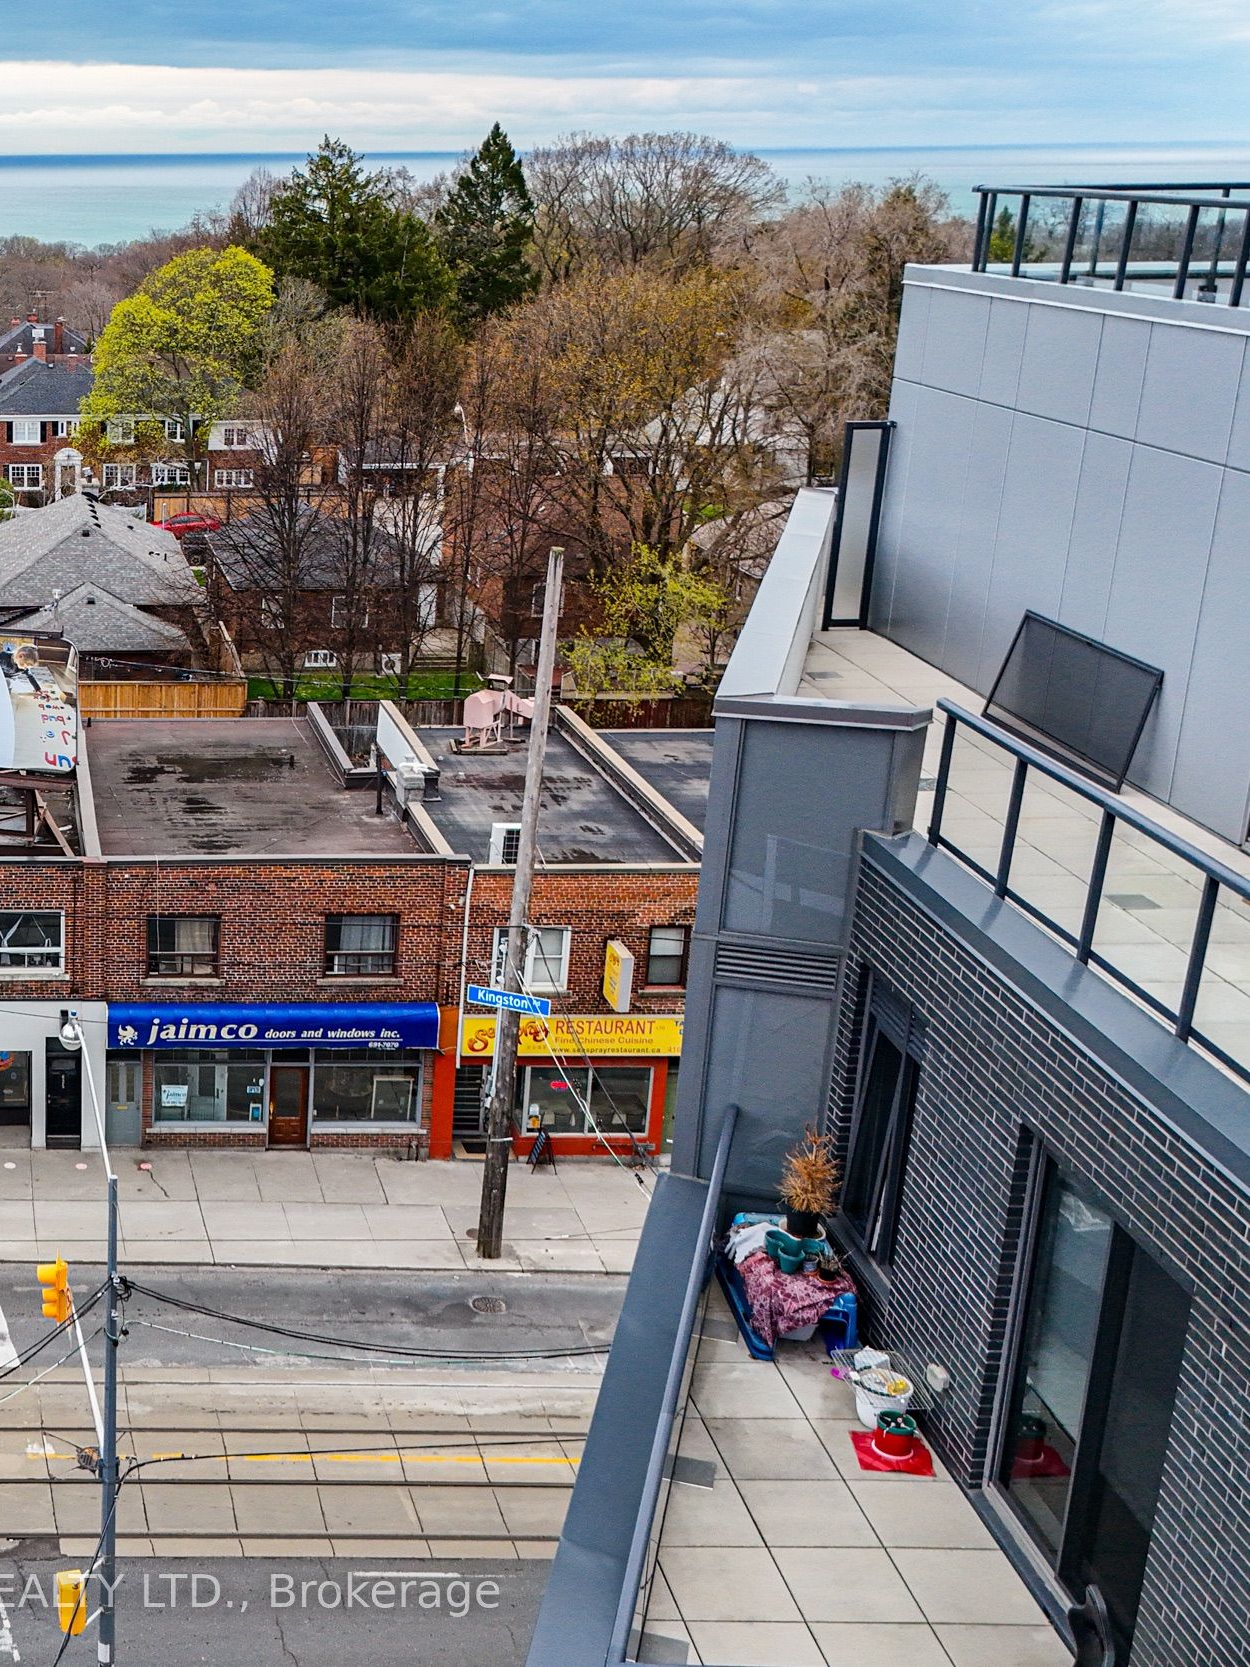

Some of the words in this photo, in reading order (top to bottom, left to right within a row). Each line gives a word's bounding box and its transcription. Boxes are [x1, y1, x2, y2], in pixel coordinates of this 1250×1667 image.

[477, 989, 528, 1009] Kingston
[146, 1017, 258, 1045] jaimco
[265, 1028, 296, 1039] doors
[301, 1028, 324, 1038] and
[327, 1028, 376, 1038] windows
[380, 1028, 400, 1038] inc.
[555, 1020, 656, 1035] RESTAURANT
[554, 1036, 575, 1044] Fine
[579, 1036, 616, 1044] Chinese
[618, 1036, 654, 1044] Cuisine
